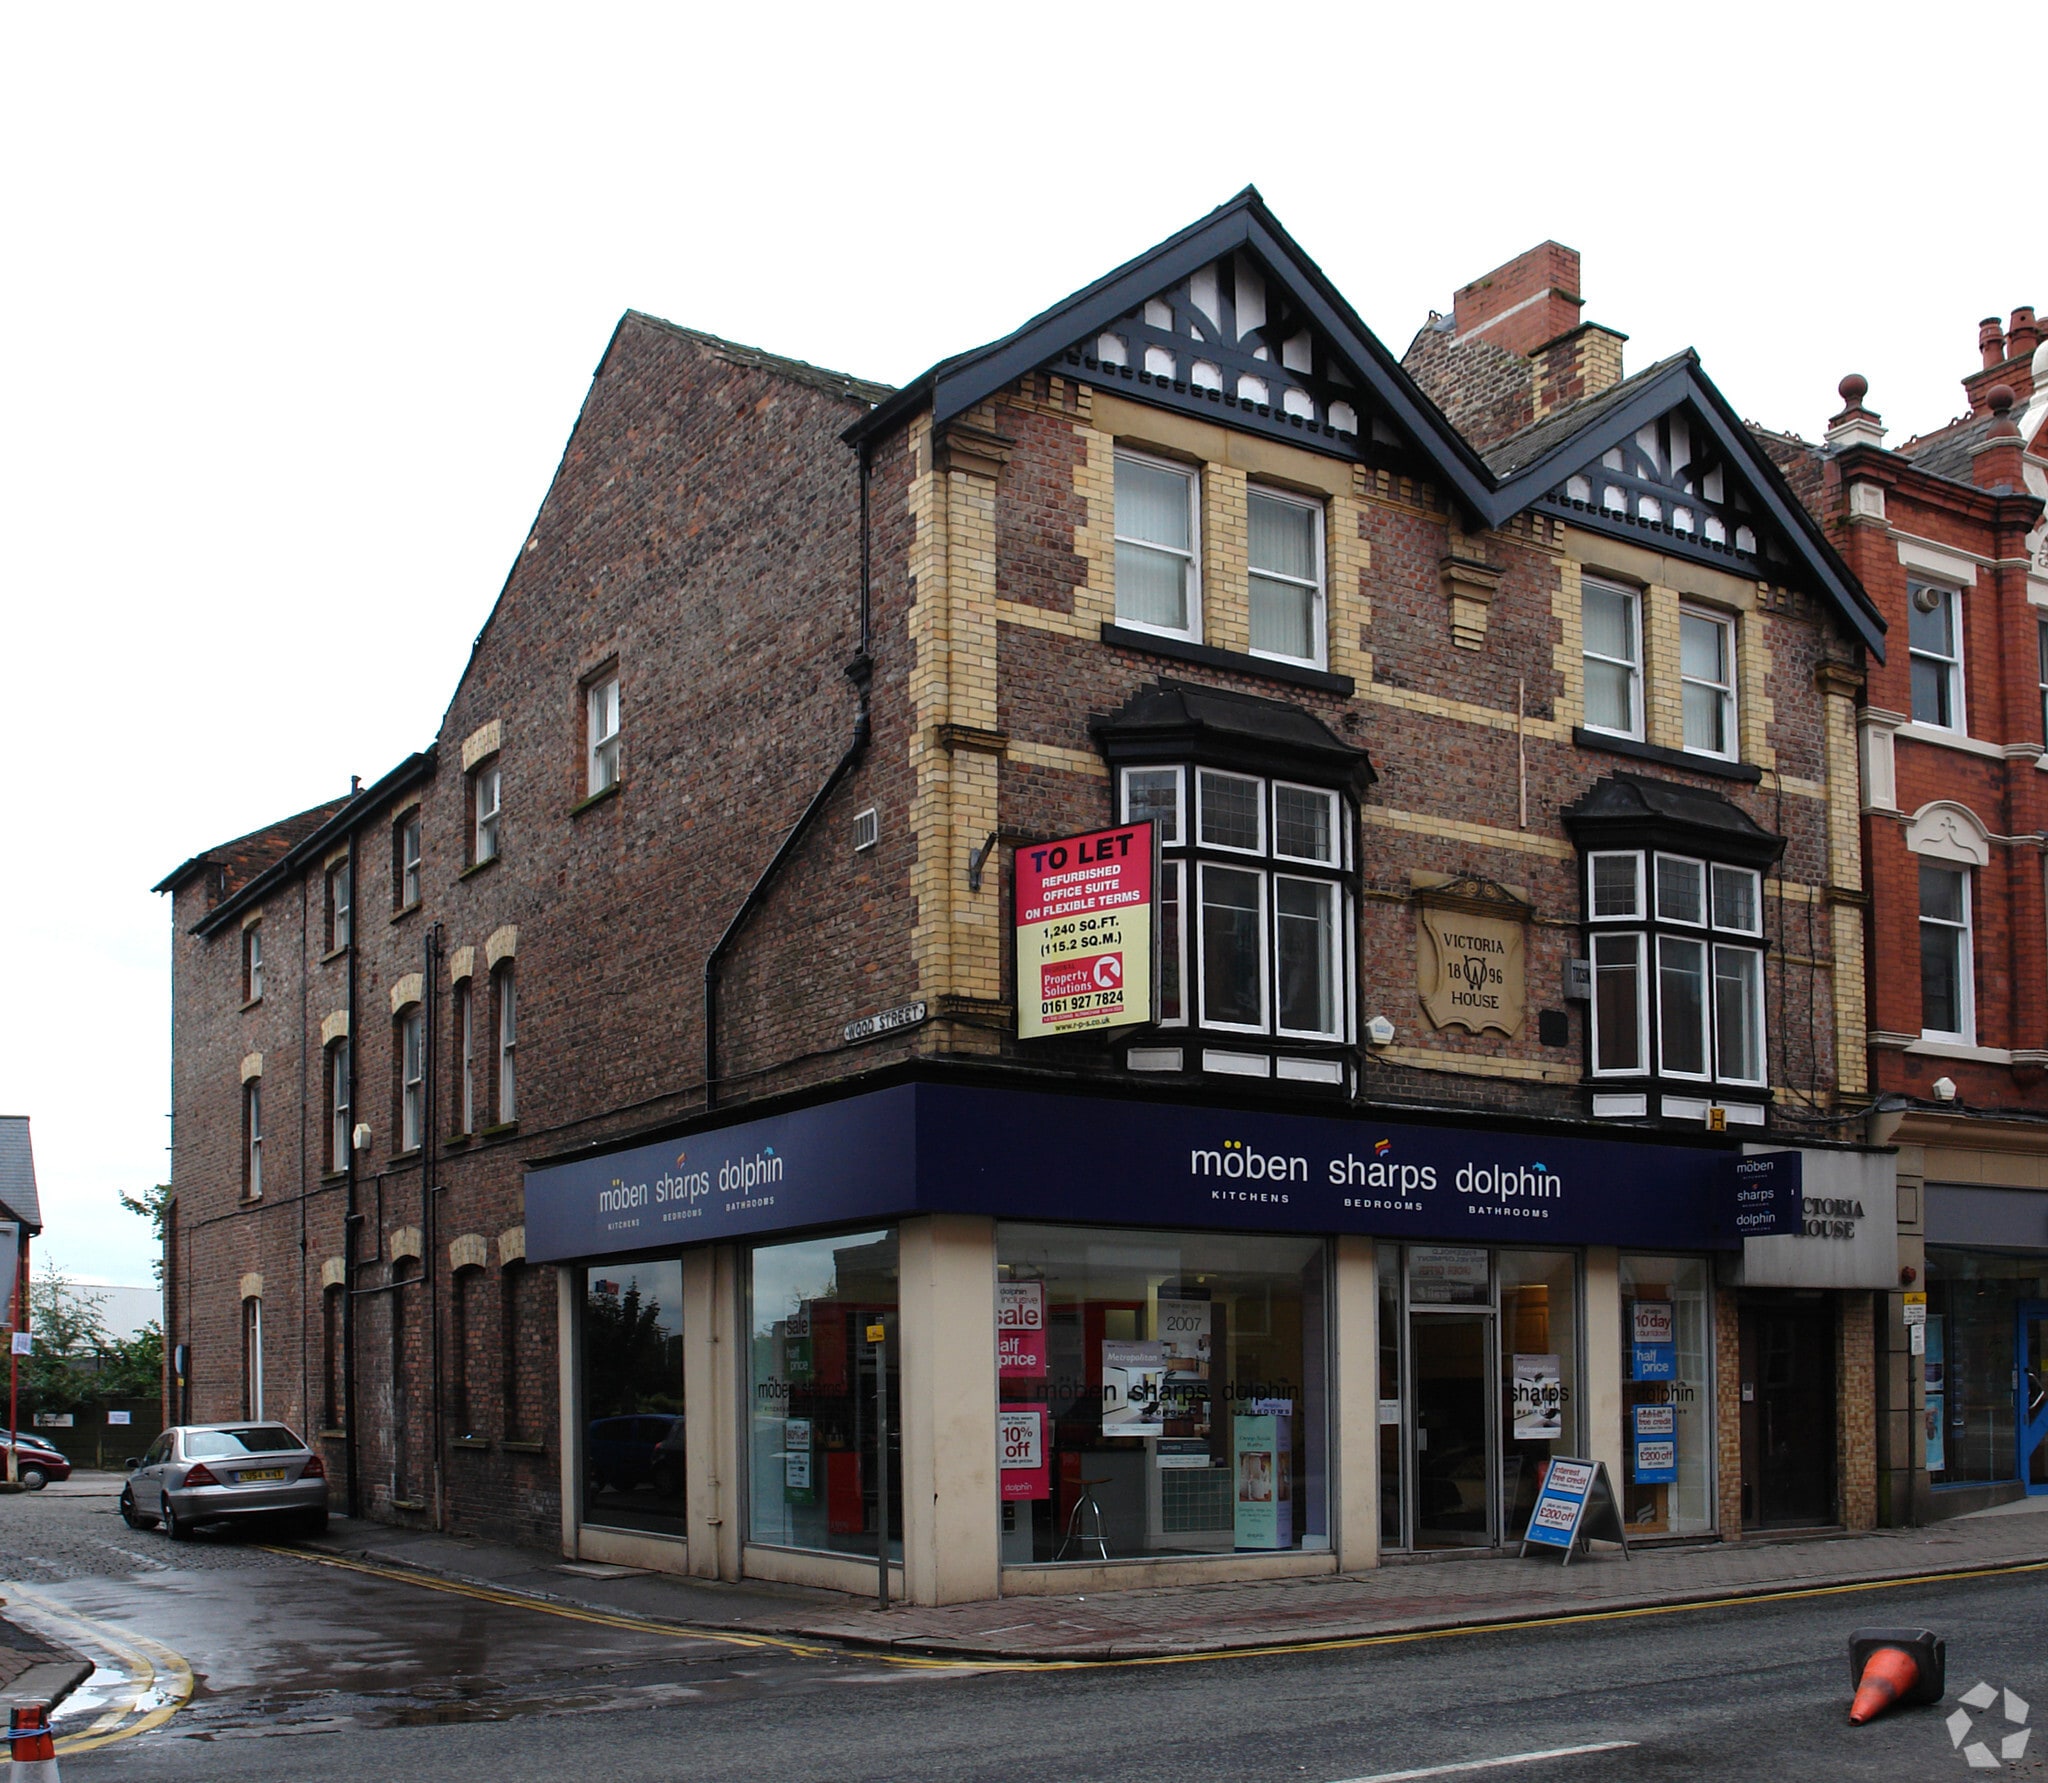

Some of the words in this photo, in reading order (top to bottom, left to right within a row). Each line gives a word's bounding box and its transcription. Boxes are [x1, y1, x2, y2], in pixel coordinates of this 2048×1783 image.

[1031, 847, 1068, 873] TO
[1079, 833, 1134, 865] LET
[1042, 864, 1121, 888] REFURBISHED
[1043, 885, 1082, 902] OFFICE
[1085, 879, 1120, 894] SUITE
[1025, 907, 1041, 920] ON
[1043, 897, 1096, 916] FLEXIBLE
[1099, 890, 1141, 906] TERMS
[1043, 923, 1076, 940] 1,240
[1079, 916, 1119, 932] SQ.FT.
[1041, 939, 1078, 957] (115.2
[1081, 931, 1122, 948] SQ.M.)
[1443, 933, 1504, 954] VICTORIA
[1044, 970, 1088, 986] Property
[1448, 963, 1461, 979] 18
[1490, 968, 1503, 984] 96
[1044, 981, 1092, 997] Solutions
[1042, 997, 1067, 1015] 0161
[1071, 995, 1092, 1010] 927
[1095, 990, 1124, 1007] 7824
[1452, 991, 1500, 1009] HOUSE
[848, 1019, 874, 1039] WOOD
[880, 1005, 919, 1029] STREET
[1191, 1140, 1308, 1182] möben
[1328, 1153, 1437, 1197] sharps
[1455, 1161, 1561, 1202] dolphin
[1737, 1160, 1774, 1173] möben
[600, 1178, 648, 1213] möben
[655, 1172, 710, 1204] sharps
[718, 1151, 783, 1195] dolphin
[1737, 1189, 1774, 1201] sharps
[1211, 1190, 1289, 1203] KITCHENS
[1344, 1198, 1423, 1211] BEDROOMS
[1468, 1205, 1549, 1218] BATHROOMS
[1802, 1197, 1865, 1218] CTORIA
[607, 1218, 640, 1231] KITCHENS
[662, 1208, 703, 1222] BEDROOMS
[725, 1196, 775, 1212] BATHROOMS
[1736, 1212, 1776, 1226] dolphin
[786, 1319, 808, 1335] sale
[1167, 1316, 1202, 1331] 2007
[1636, 1314, 1649, 1328] 10
[1650, 1314, 1671, 1330] day
[1000, 1338, 1019, 1354] alf
[1107, 1352, 1158, 1363] Metropolitan
[1637, 1349, 1657, 1364] half
[790, 1360, 808, 1373] price
[1642, 1361, 1669, 1374] price
[1132, 1379, 1209, 1405] sharps
[1222, 1379, 1300, 1405] dolphin
[1511, 1382, 1569, 1406] sharps
[1002, 1426, 1033, 1442] 10%
[1005, 1441, 1030, 1458] off
[1640, 1451, 1661, 1461] £200
[1661, 1451, 1673, 1460] off
[1552, 1473, 1566, 1482] free
[1566, 1476, 1587, 1486] credit
[1539, 1507, 1562, 1520] £200
[1561, 1512, 1576, 1522] off
